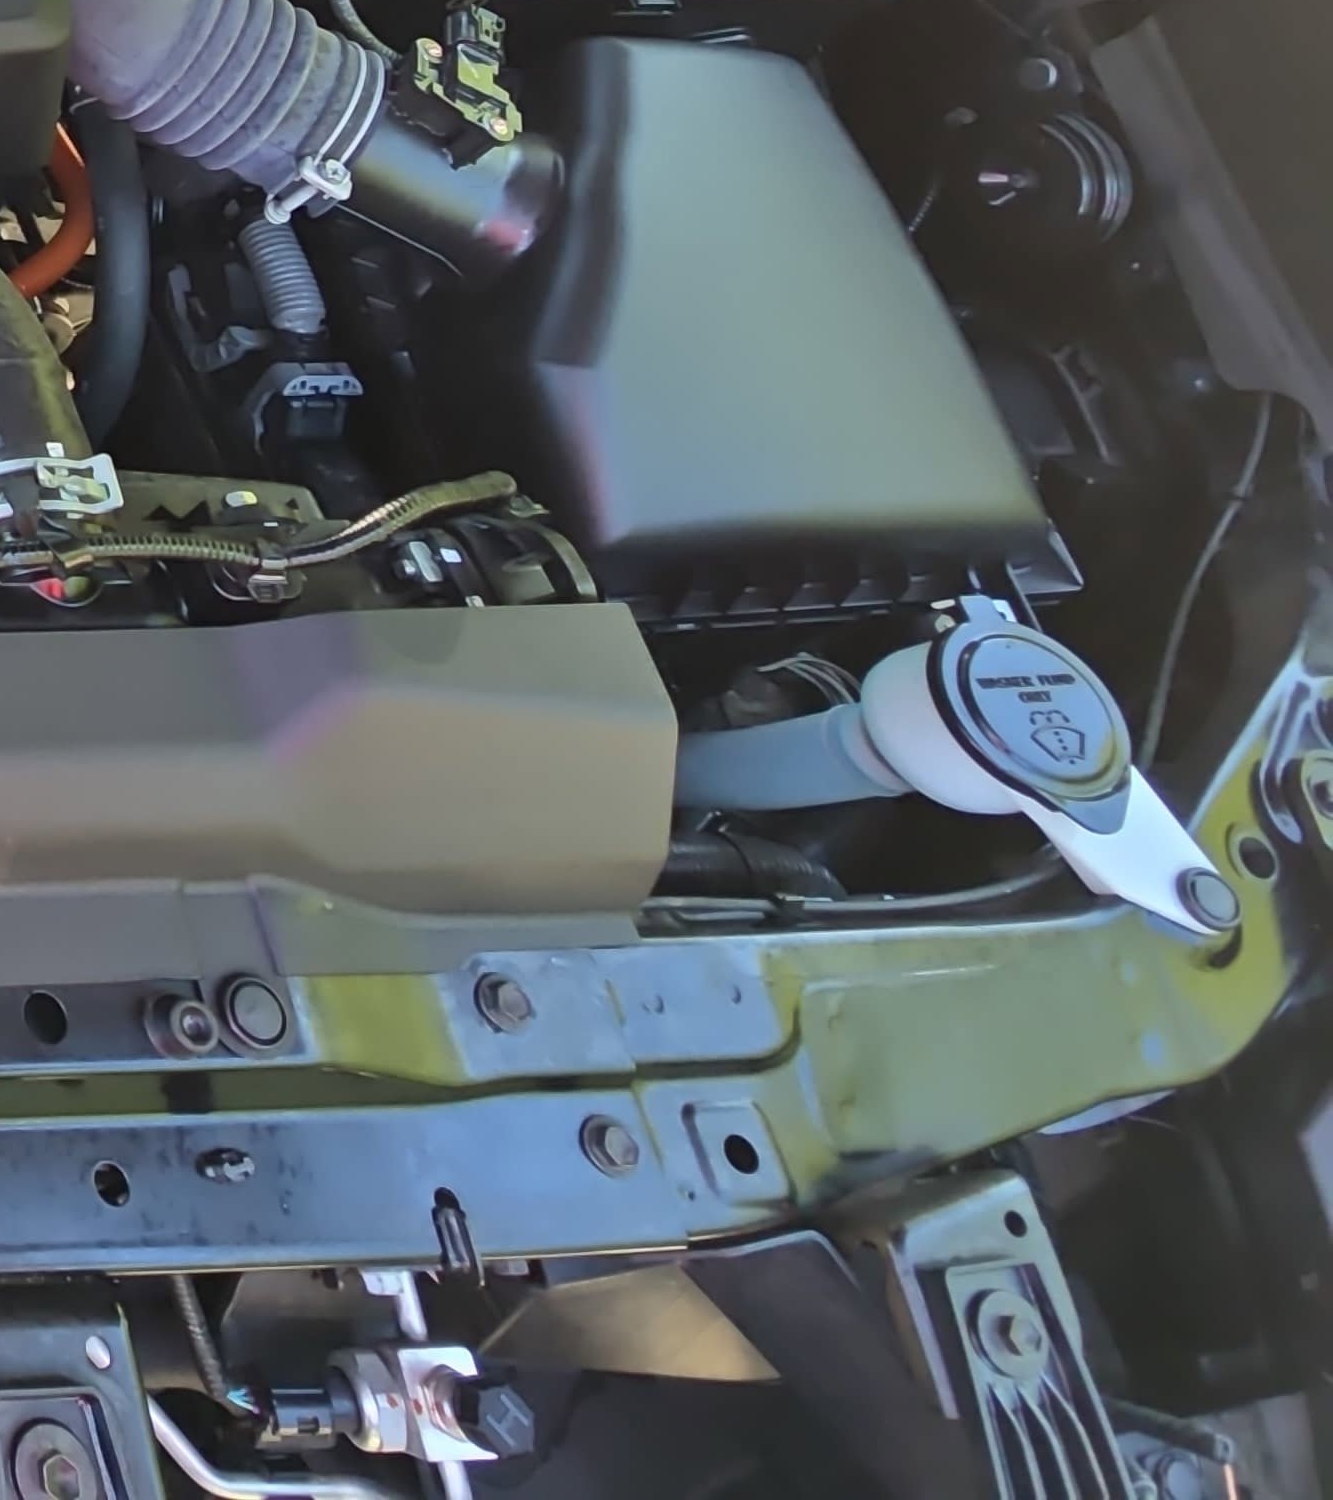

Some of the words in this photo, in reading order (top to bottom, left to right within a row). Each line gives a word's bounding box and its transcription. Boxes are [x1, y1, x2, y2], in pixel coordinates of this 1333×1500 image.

[975, 675, 1035, 690] WASHER
[1036, 673, 1076, 686] FLUID
[1018, 690, 1052, 704] ONLY
